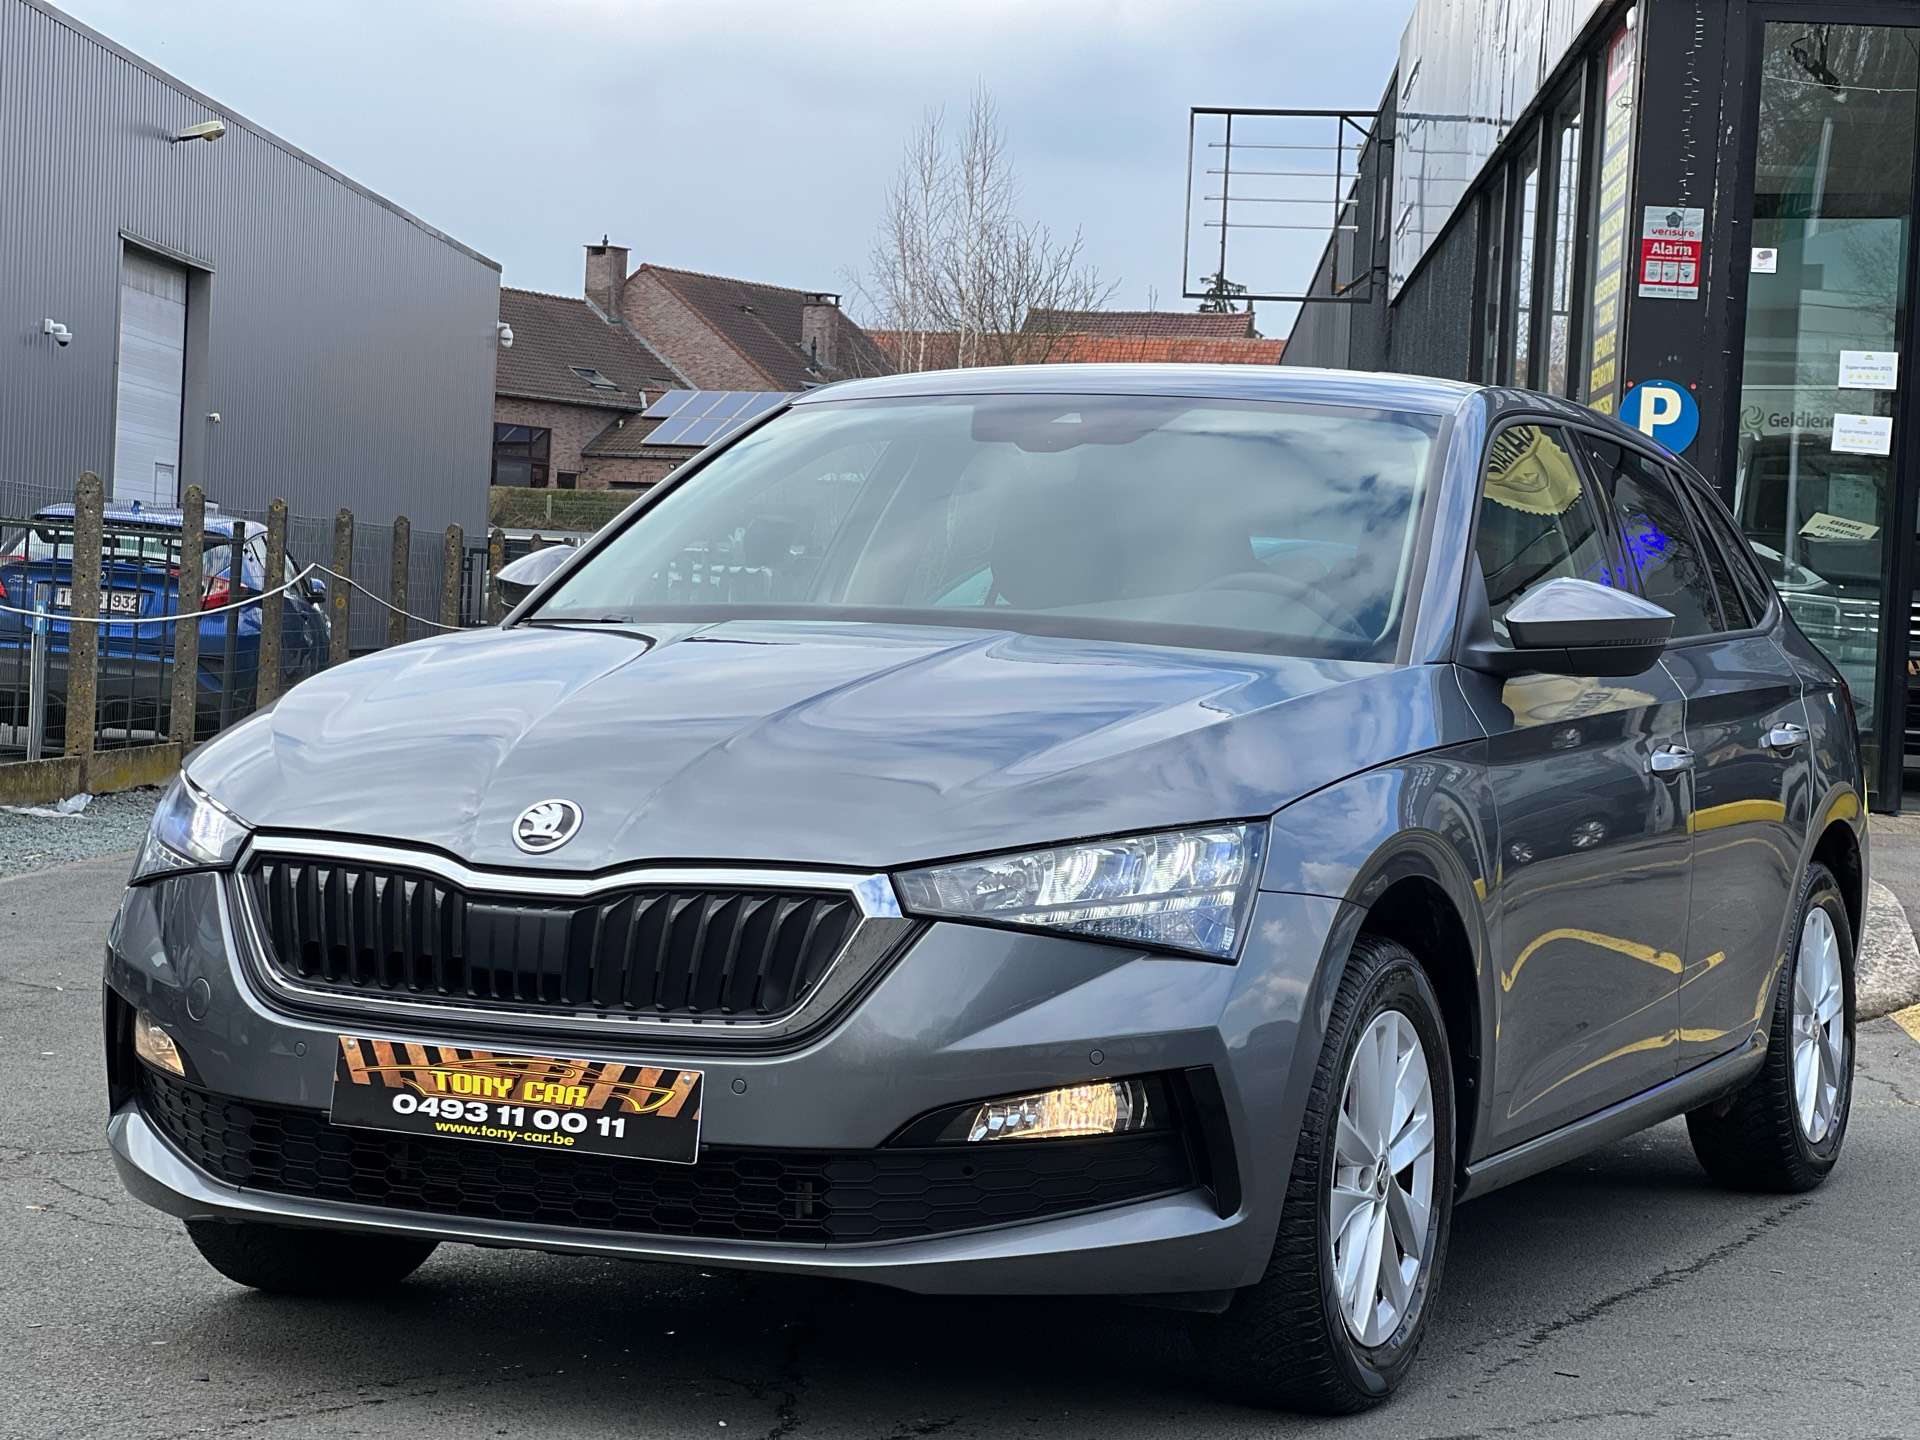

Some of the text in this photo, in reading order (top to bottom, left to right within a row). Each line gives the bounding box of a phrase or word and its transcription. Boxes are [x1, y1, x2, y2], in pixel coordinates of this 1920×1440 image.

[1651, 228, 1695, 237] verisure
[1651, 242, 1692, 256] Alarm
[1639, 386, 1682, 437] P
[1768, 411, 1835, 428] Geldien
[428, 1070, 588, 1108] TONY CAR
[392, 1094, 626, 1138] 0493 11 00 11
[434, 1120, 576, 1147] www.tony-car.be
